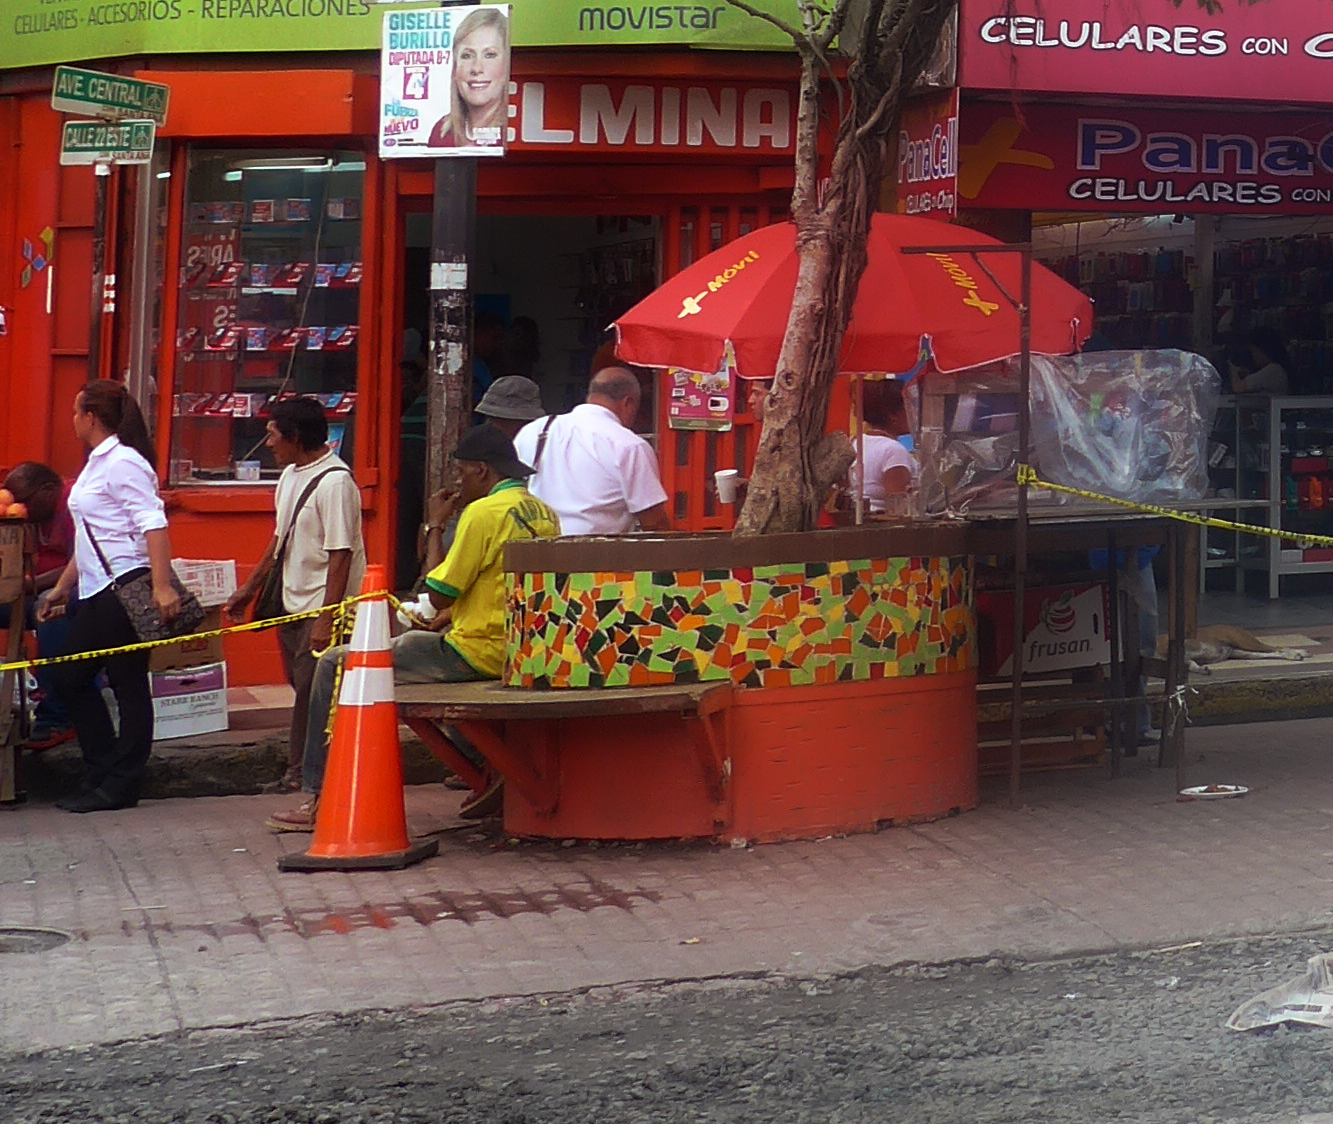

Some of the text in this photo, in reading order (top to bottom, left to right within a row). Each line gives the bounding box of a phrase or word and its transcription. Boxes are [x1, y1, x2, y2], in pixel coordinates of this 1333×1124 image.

[15, 8, 78, 35] CELULARES
[87, 0, 182, 26] ACCESORIOS
[389, 13, 450, 30] GISELLE
[579, 6, 726, 31] movistar
[389, 31, 450, 49] BURILLO
[980, 16, 1228, 56] CELULARES
[1241, 37, 1288, 56] CON
[389, 51, 434, 65] DIPUTADA
[89, 78, 142, 106] CENTRAL
[579, 84, 790, 148] MINA
[65, 127, 94, 148] CALLE
[106, 126, 131, 147] ESTE
[1068, 178, 1282, 205] CELULARES
[1292, 189, 1331, 203] CON
[1028, 638, 1091, 663] frusan
